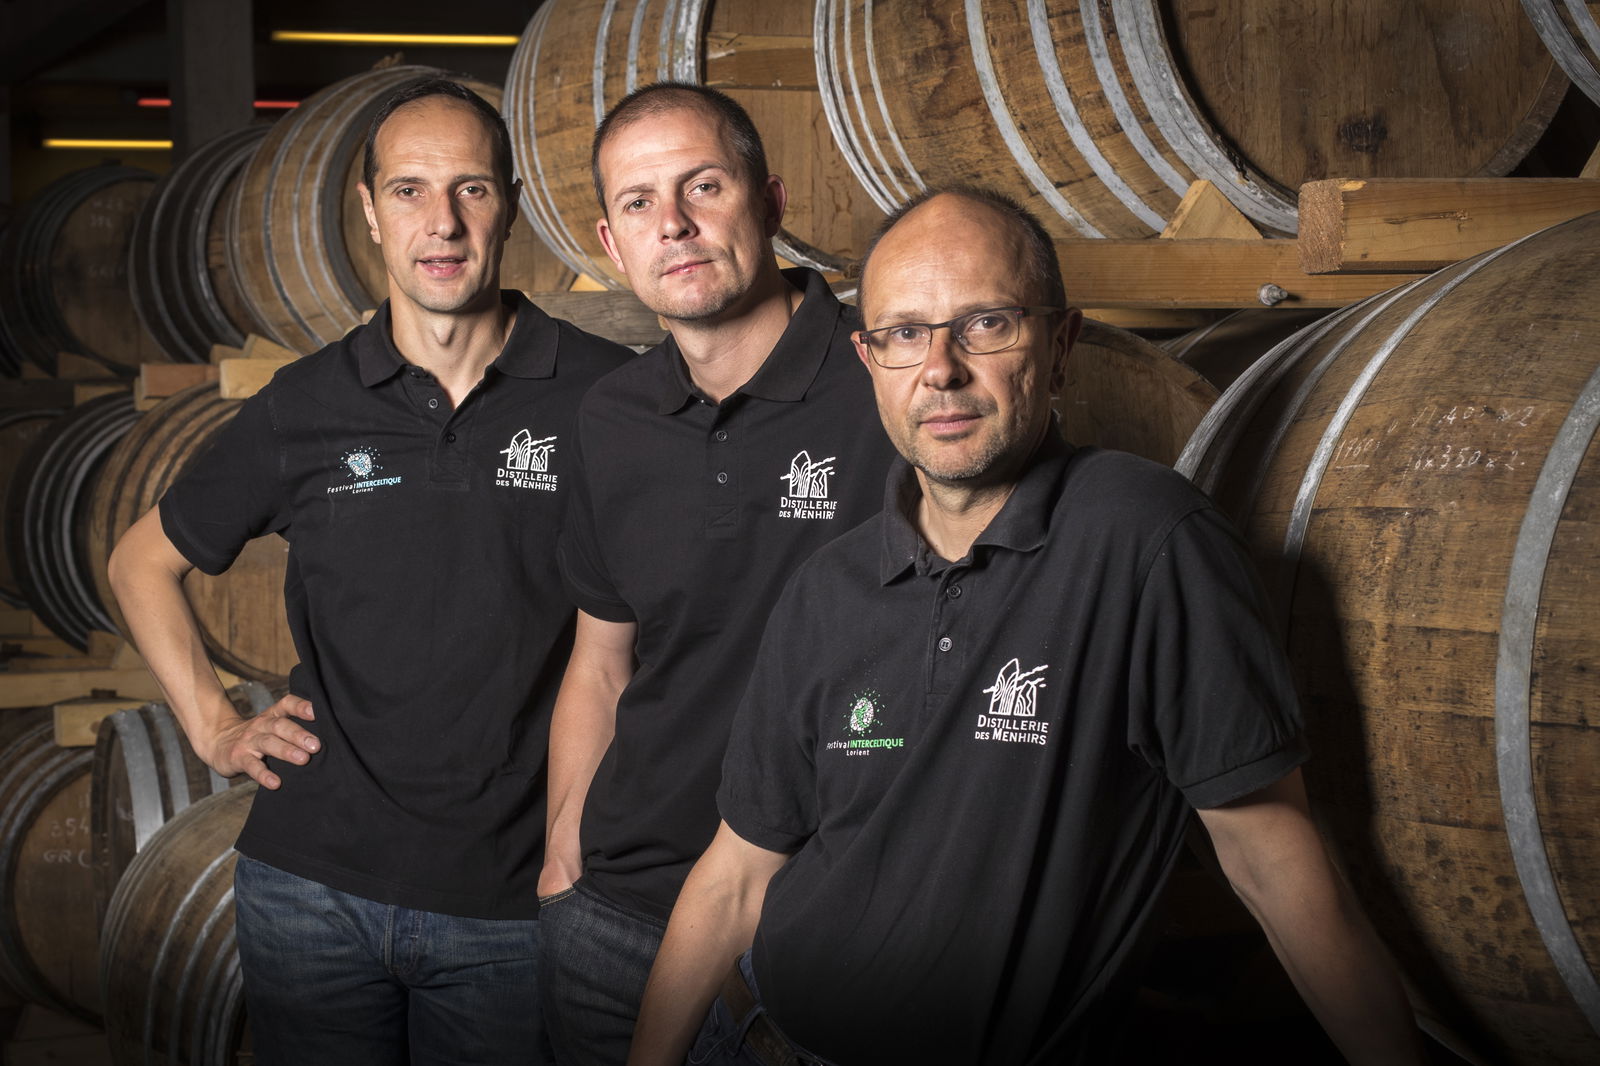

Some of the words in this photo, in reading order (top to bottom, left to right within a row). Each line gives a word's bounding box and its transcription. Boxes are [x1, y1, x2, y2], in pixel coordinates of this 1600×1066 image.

[497, 468, 558, 483] DISTILLERIE
[496, 479, 510, 487] DES
[513, 478, 557, 492] MENHIRS
[780, 496, 838, 510] DISTILLERIE
[779, 510, 791, 518] DES
[793, 508, 835, 520] MENHIRS
[977, 714, 1049, 733] DISTILLERIE
[975, 731, 990, 740] DES
[992, 728, 1047, 746] MENHIRS
